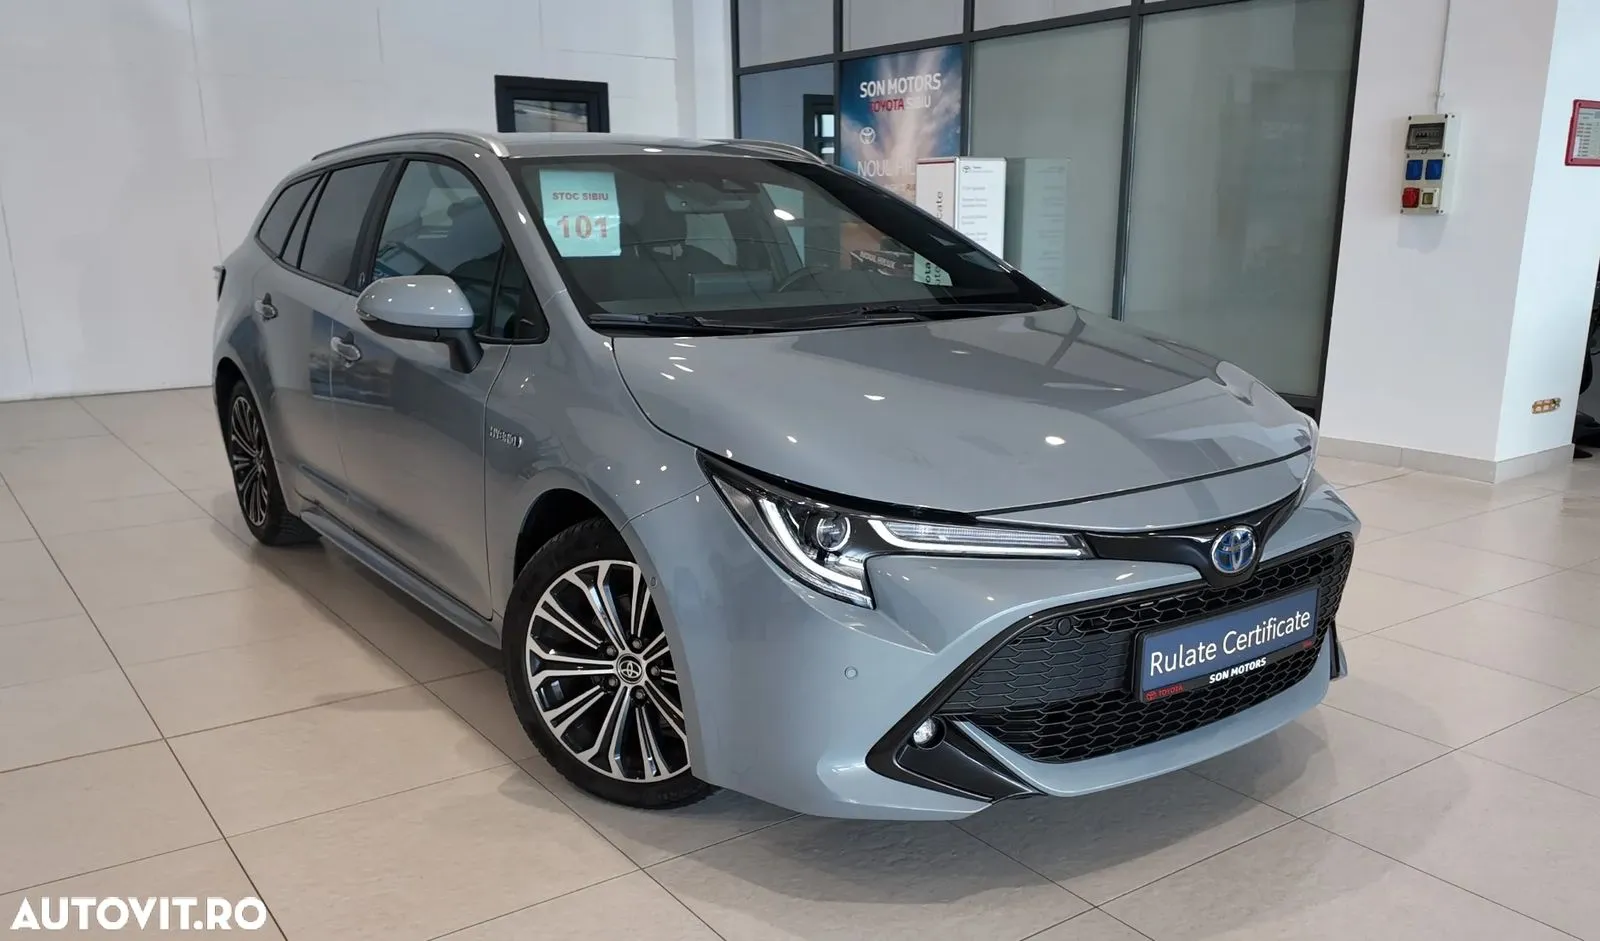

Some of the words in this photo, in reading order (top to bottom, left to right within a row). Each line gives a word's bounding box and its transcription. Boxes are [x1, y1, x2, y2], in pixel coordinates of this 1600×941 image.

[860, 81, 885, 98] SON
[887, 73, 942, 95] MOTORS
[869, 98, 905, 113] TOYOTA
[895, 160, 916, 177] HIL
[552, 192, 580, 200] STOC
[582, 192, 609, 201] SIBIU
[936, 192, 944, 219] cate
[557, 215, 608, 238] 101
[1150, 642, 1217, 677] Rulate
[1222, 610, 1311, 654] Certificate
[1158, 683, 1184, 697] TOYOTA
[1209, 668, 1230, 684] SON
[1230, 657, 1267, 677] MOTORS
